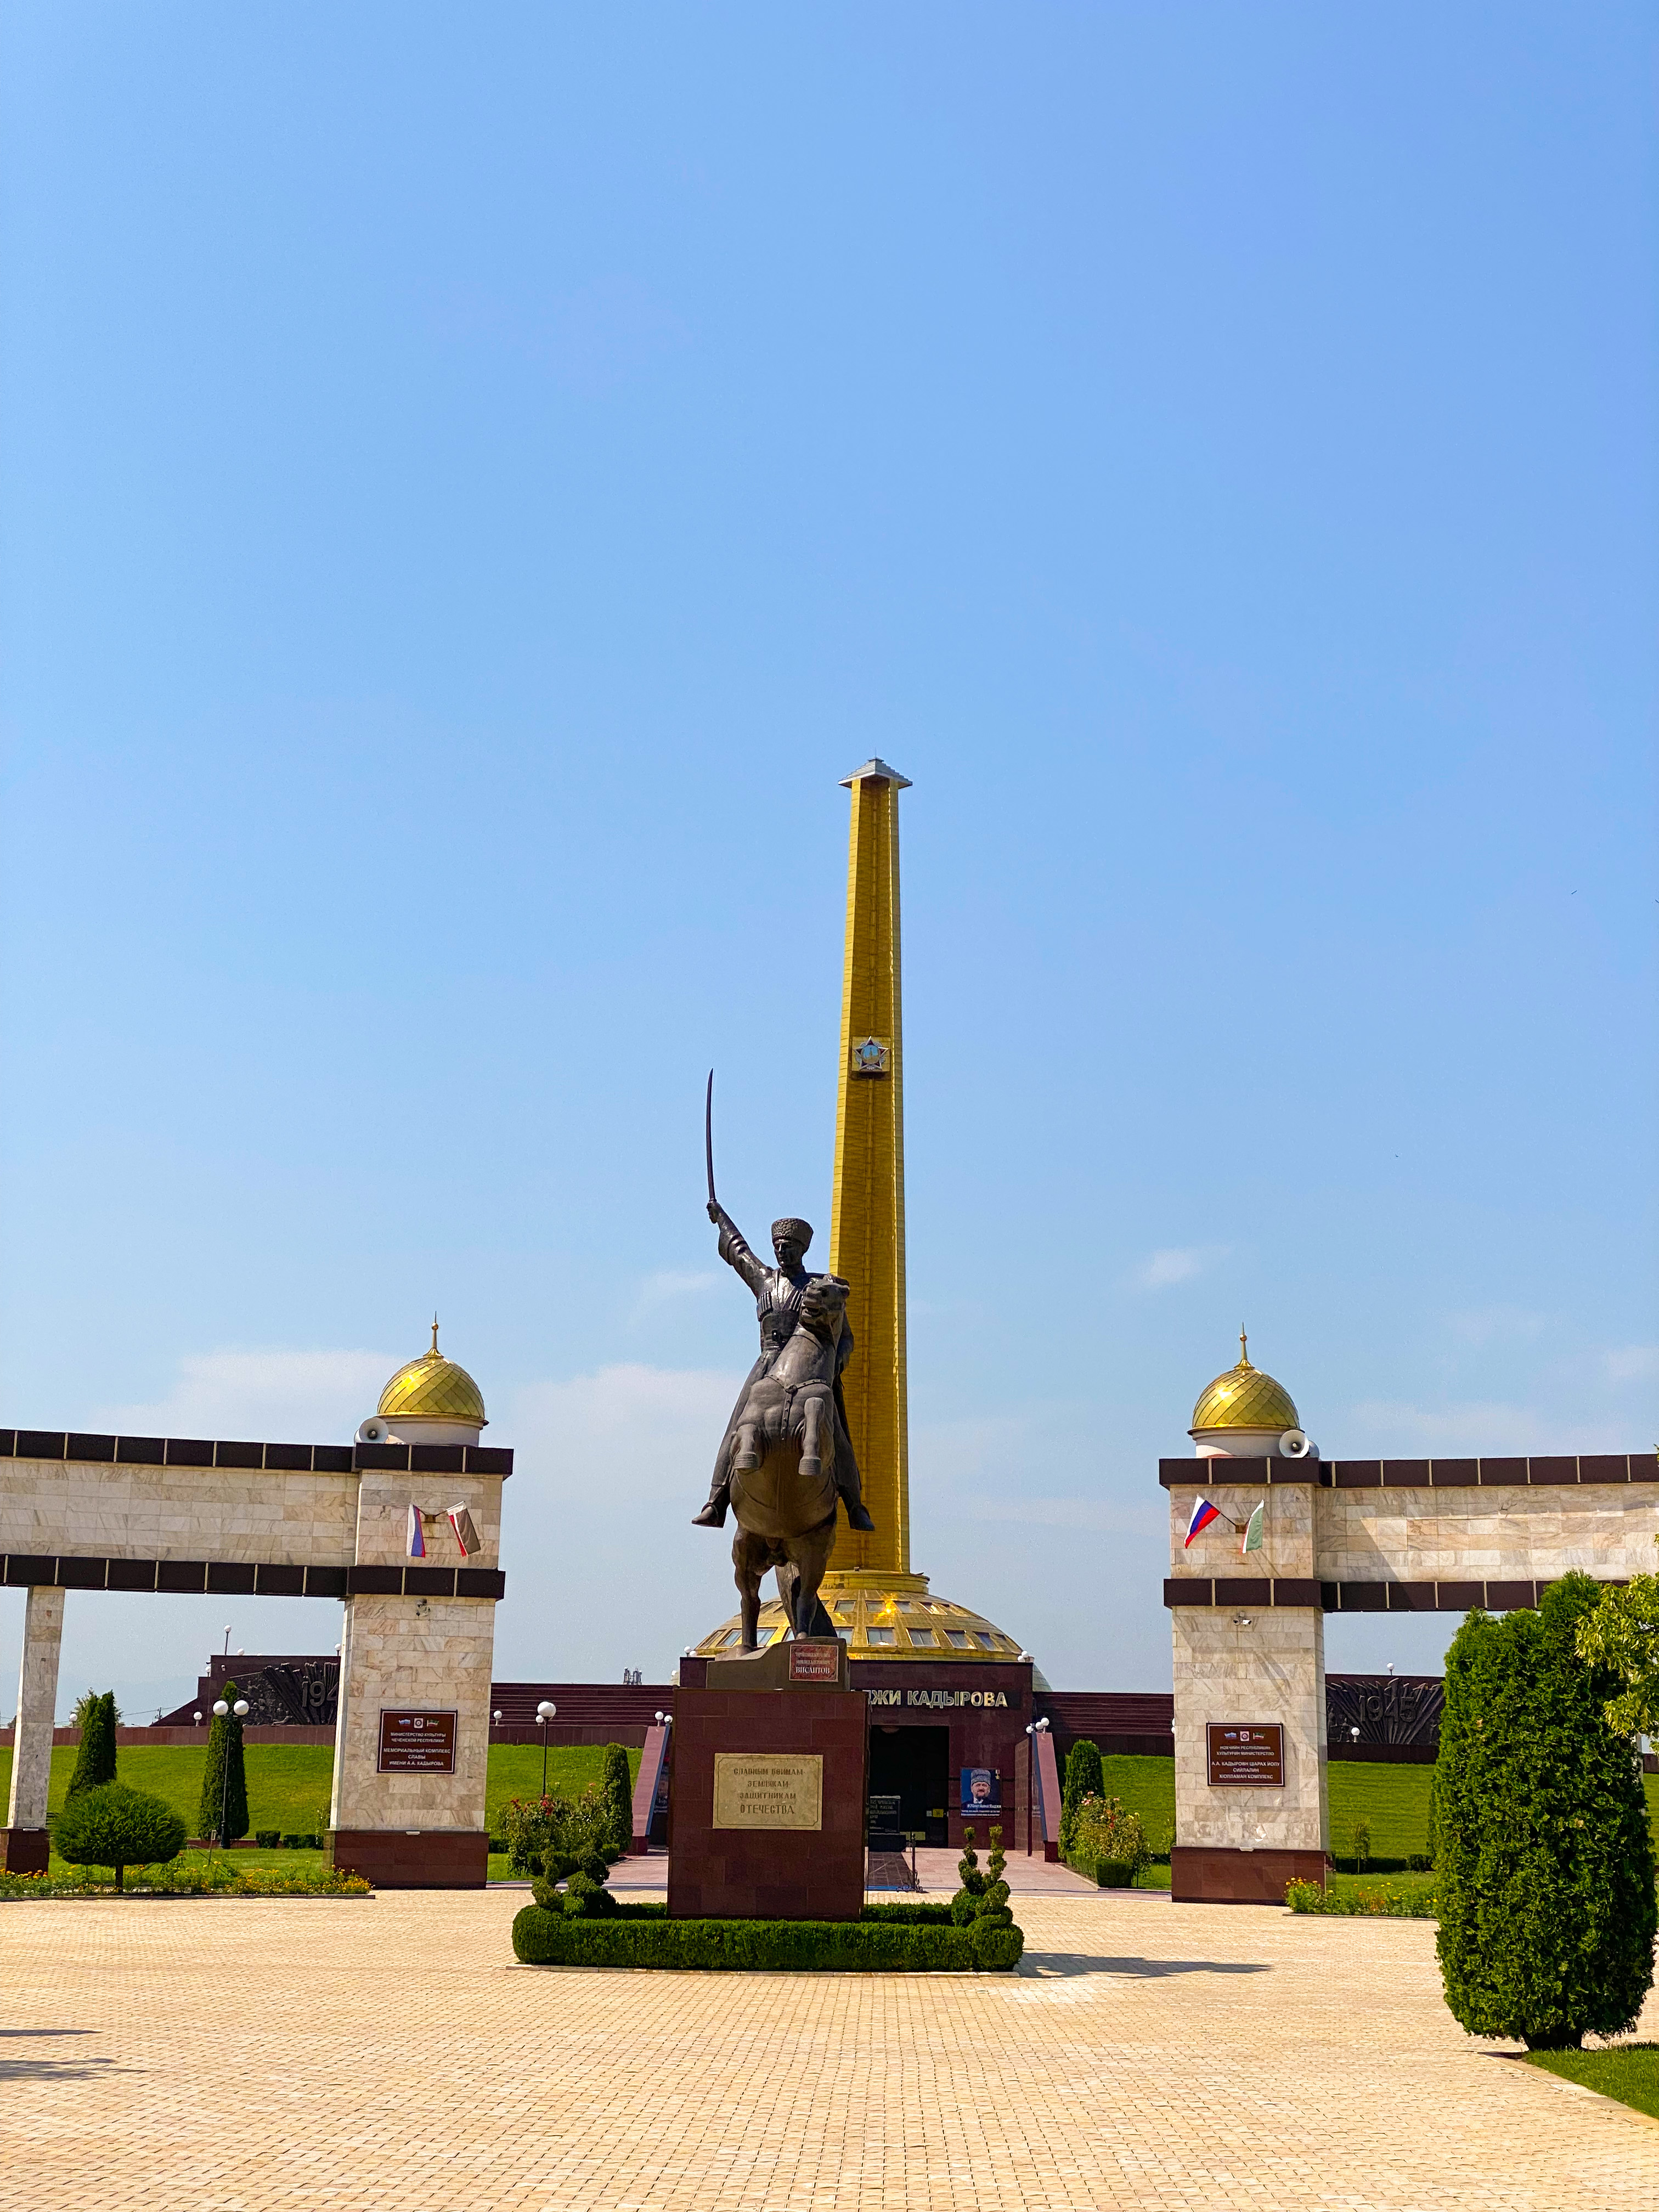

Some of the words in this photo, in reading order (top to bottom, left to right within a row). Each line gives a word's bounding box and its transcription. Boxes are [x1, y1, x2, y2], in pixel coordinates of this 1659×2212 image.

[907, 1690, 1008, 1709] КАДЫРОВА
[1359, 1695, 1417, 1722] 1945
[740, 1804, 795, 1814] ОТЕЧЕСТВА
